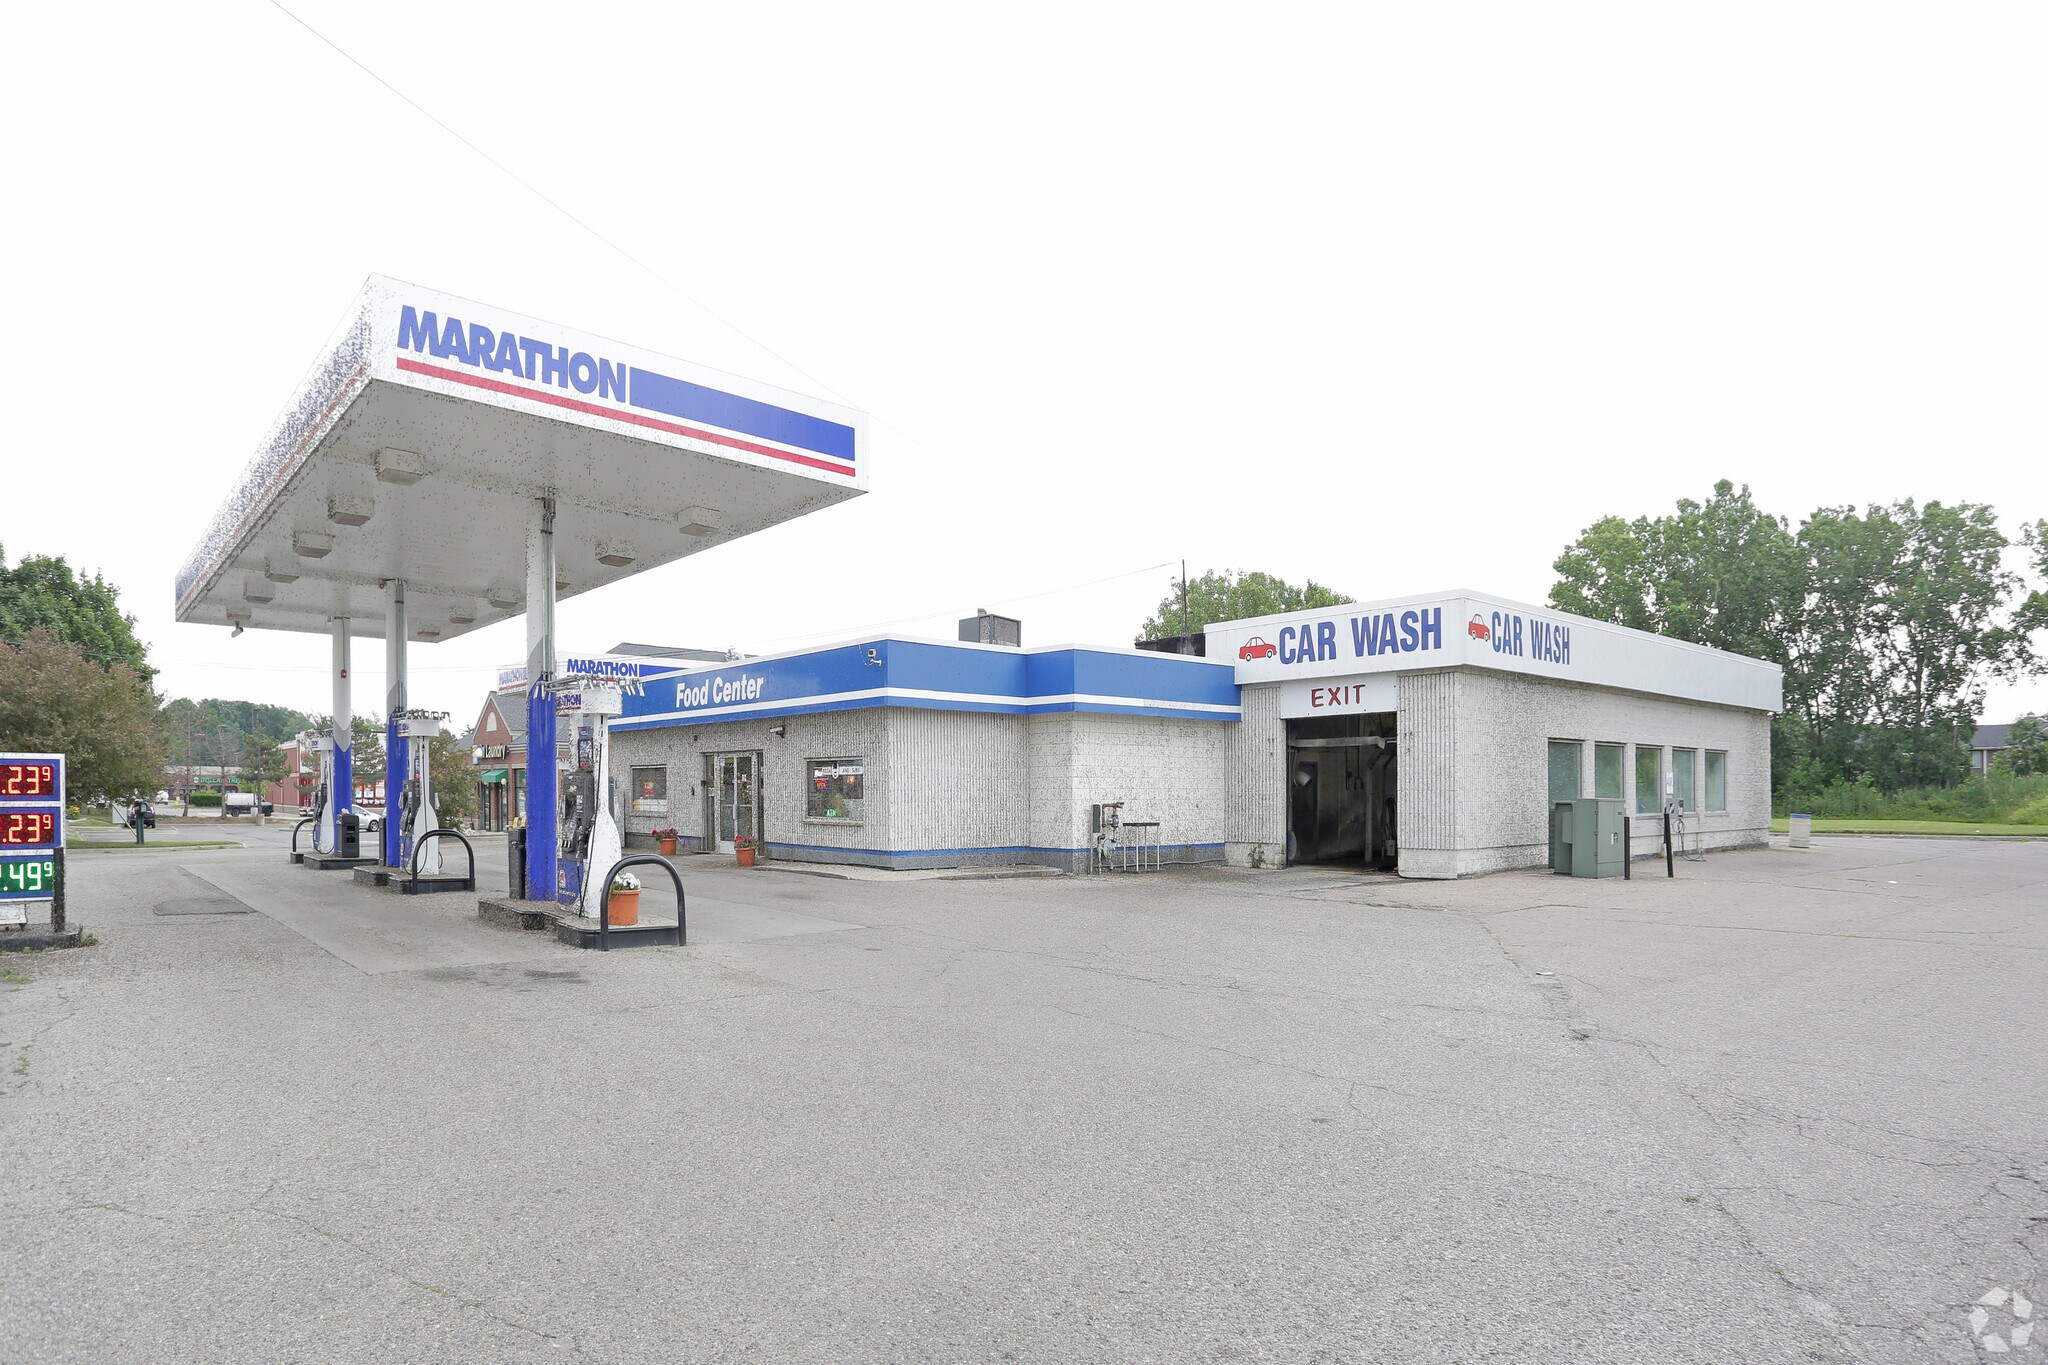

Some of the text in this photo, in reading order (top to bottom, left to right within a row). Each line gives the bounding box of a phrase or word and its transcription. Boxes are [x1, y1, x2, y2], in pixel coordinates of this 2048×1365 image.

[397, 305, 626, 404] MARATHON
[1279, 607, 1442, 664] CAR WASH
[1492, 611, 1570, 665] CAR WASH
[566, 659, 638, 677] MARATHON
[675, 674, 764, 708] Food Center
[1311, 684, 1366, 708] EXIT
